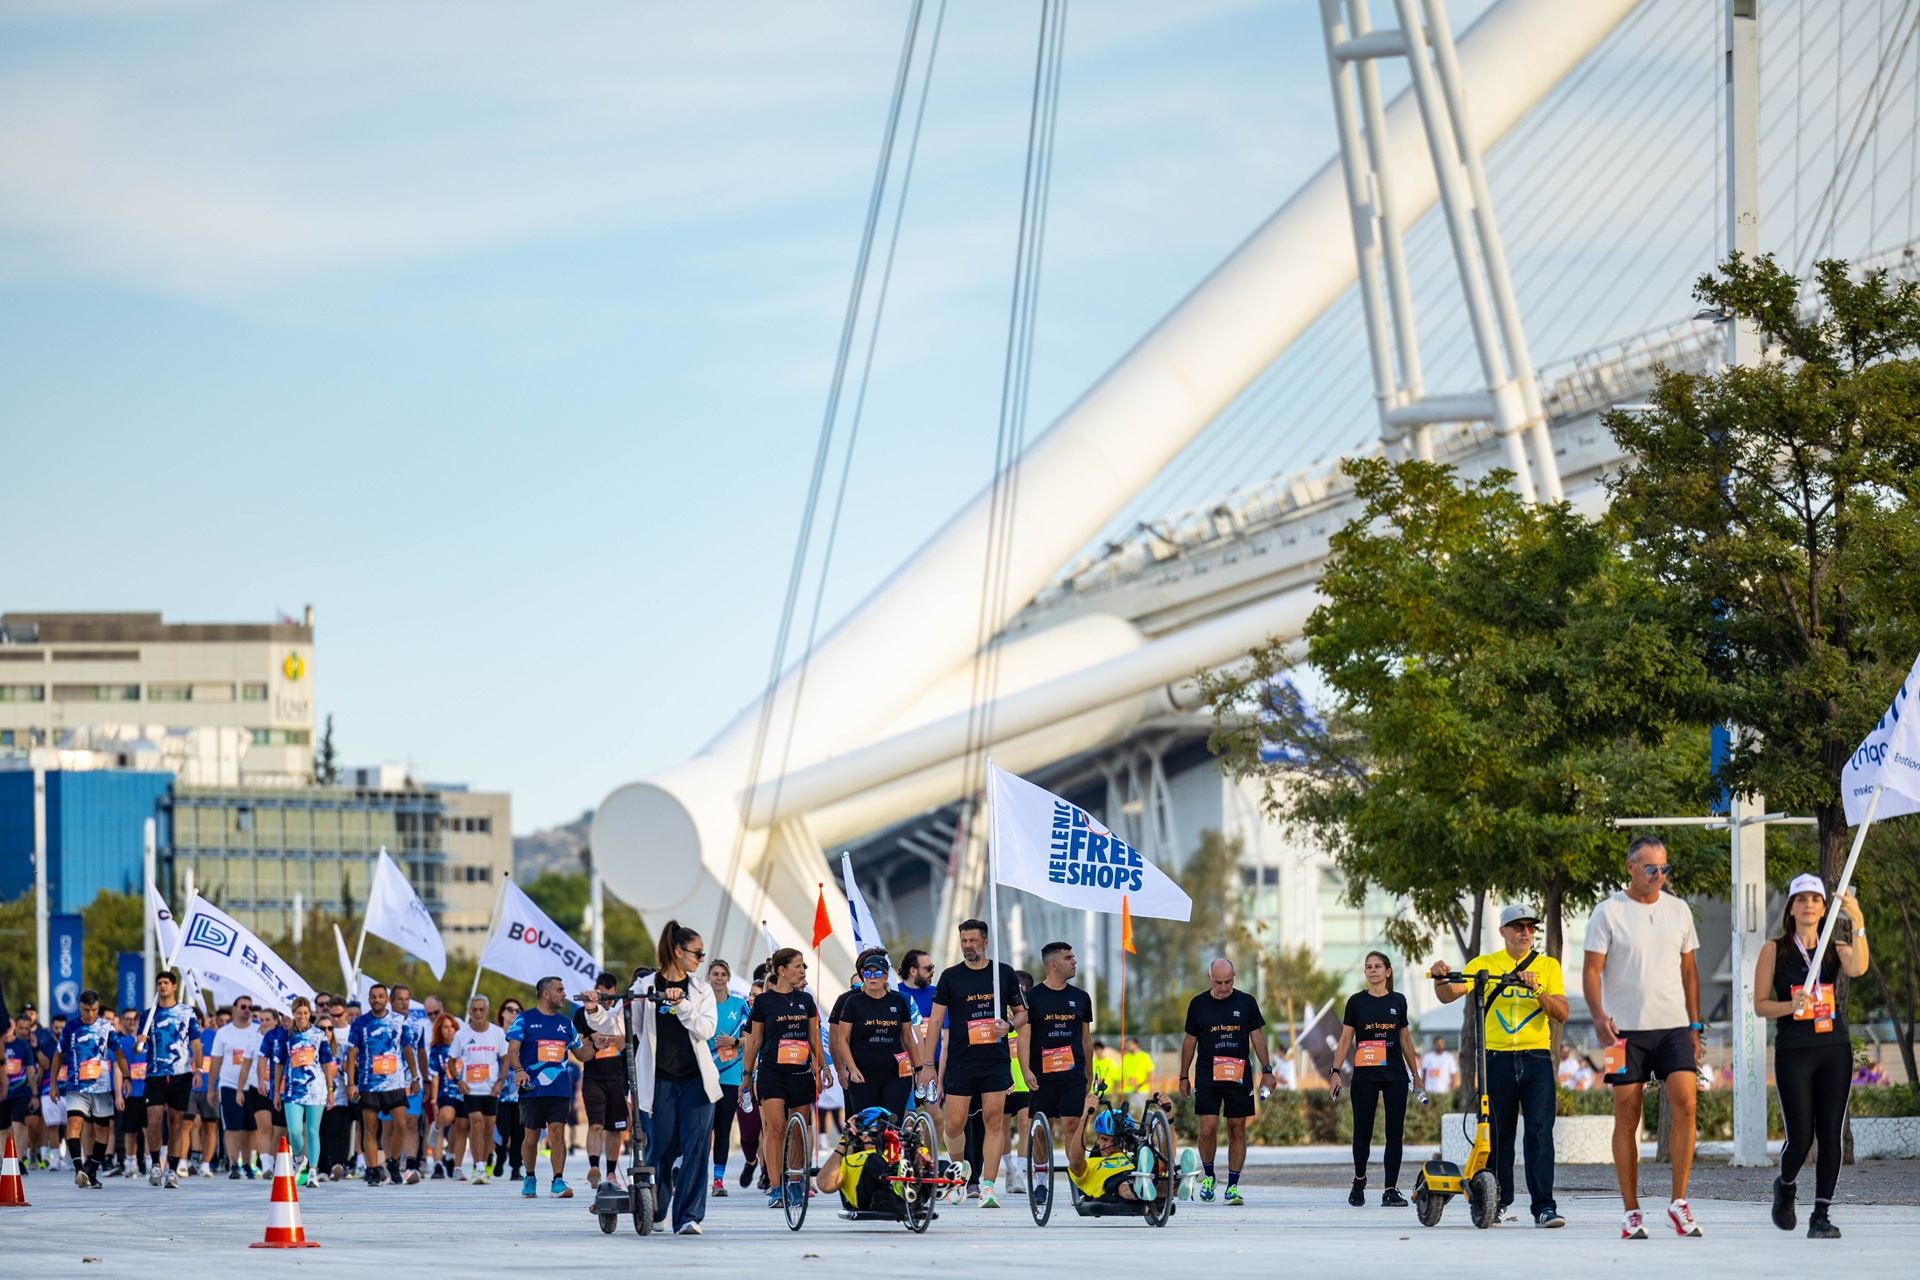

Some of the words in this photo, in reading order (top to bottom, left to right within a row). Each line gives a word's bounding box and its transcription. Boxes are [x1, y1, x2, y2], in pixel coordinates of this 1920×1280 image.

[1049, 801, 1071, 883] HELLENIC
[1070, 829, 1143, 868] FREE
[1067, 862, 1143, 892] SHOPS
[508, 921, 602, 980] BOUSSIA
[240, 959, 279, 997] SECURITIES
[977, 993, 995, 1001] lagge
[977, 1001, 990, 1009] and
[971, 1011, 983, 1019] still
[1054, 1013, 1076, 1021] lagged
[876, 1019, 898, 1027] lagged
[1375, 1022, 1397, 1030] lagged
[1220, 1024, 1240, 1032] lagged
[782, 1031, 793, 1039] still
[1214, 1041, 1226, 1049] still
